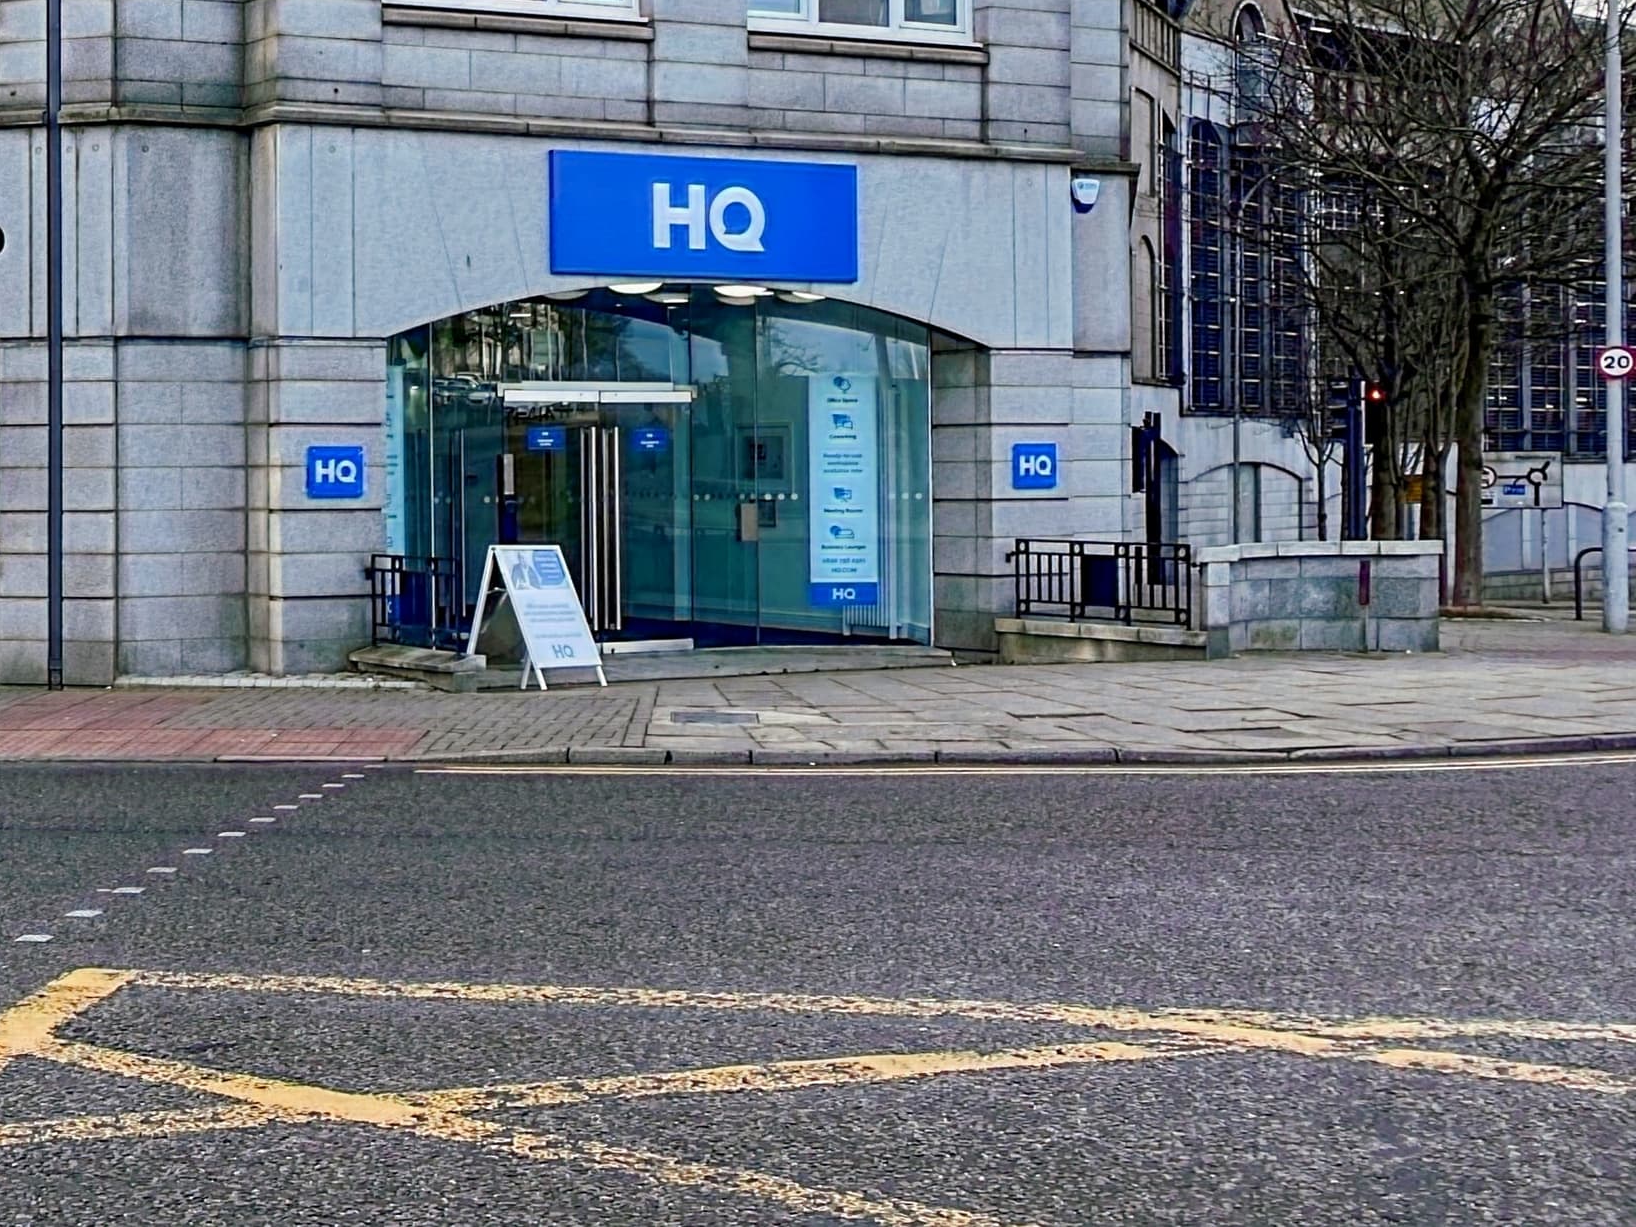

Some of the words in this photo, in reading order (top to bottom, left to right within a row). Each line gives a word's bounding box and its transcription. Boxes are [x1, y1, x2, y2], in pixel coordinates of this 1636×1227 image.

[652, 182, 765, 252] HQ
[1604, 355, 1630, 369] 20
[315, 459, 357, 483] HQ
[1019, 454, 1052, 476] HQ
[832, 588, 856, 600] HQ
[552, 644, 575, 659] HQ
